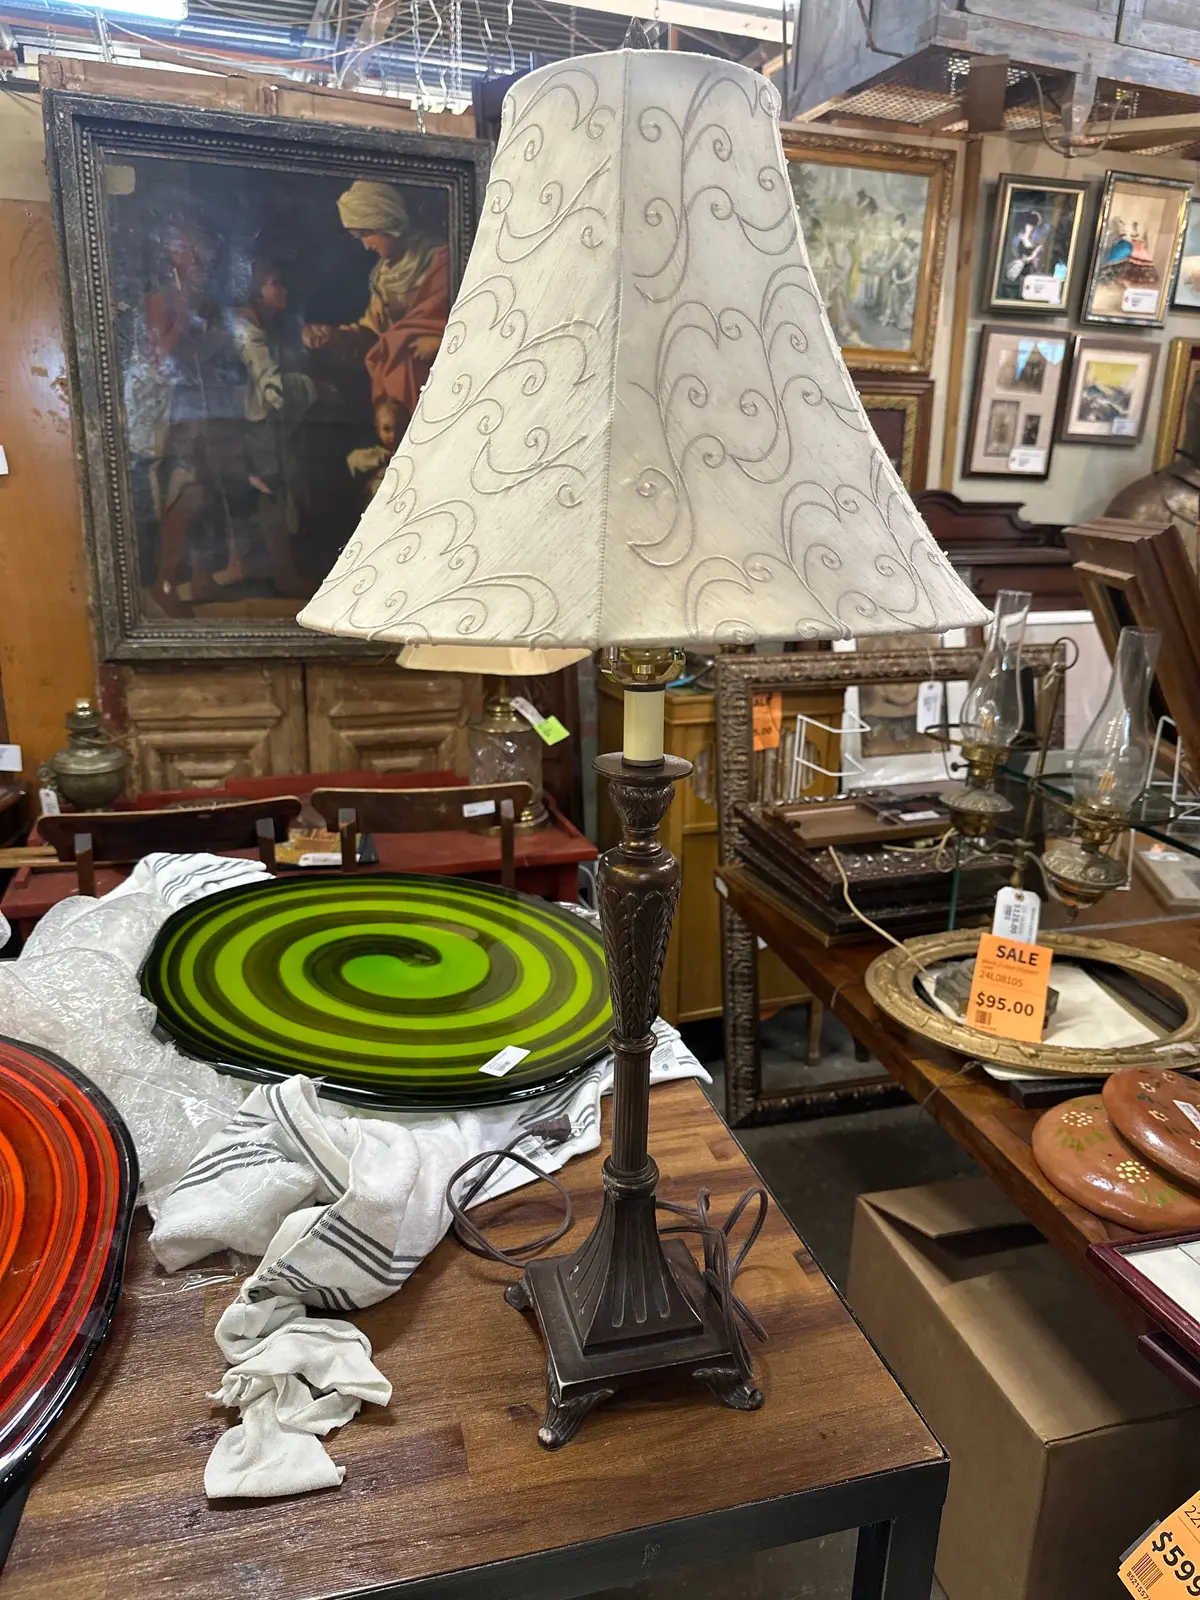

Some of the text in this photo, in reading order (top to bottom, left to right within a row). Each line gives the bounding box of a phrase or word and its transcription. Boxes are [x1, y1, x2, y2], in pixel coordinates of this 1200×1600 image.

[996, 945, 1039, 966] SALE
[979, 969, 1023, 988] 24L08105
[976, 991, 1034, 1017] $95.00
[1184, 1504, 1200, 1528] 22
[1126, 1570, 1151, 1600] 8521557
